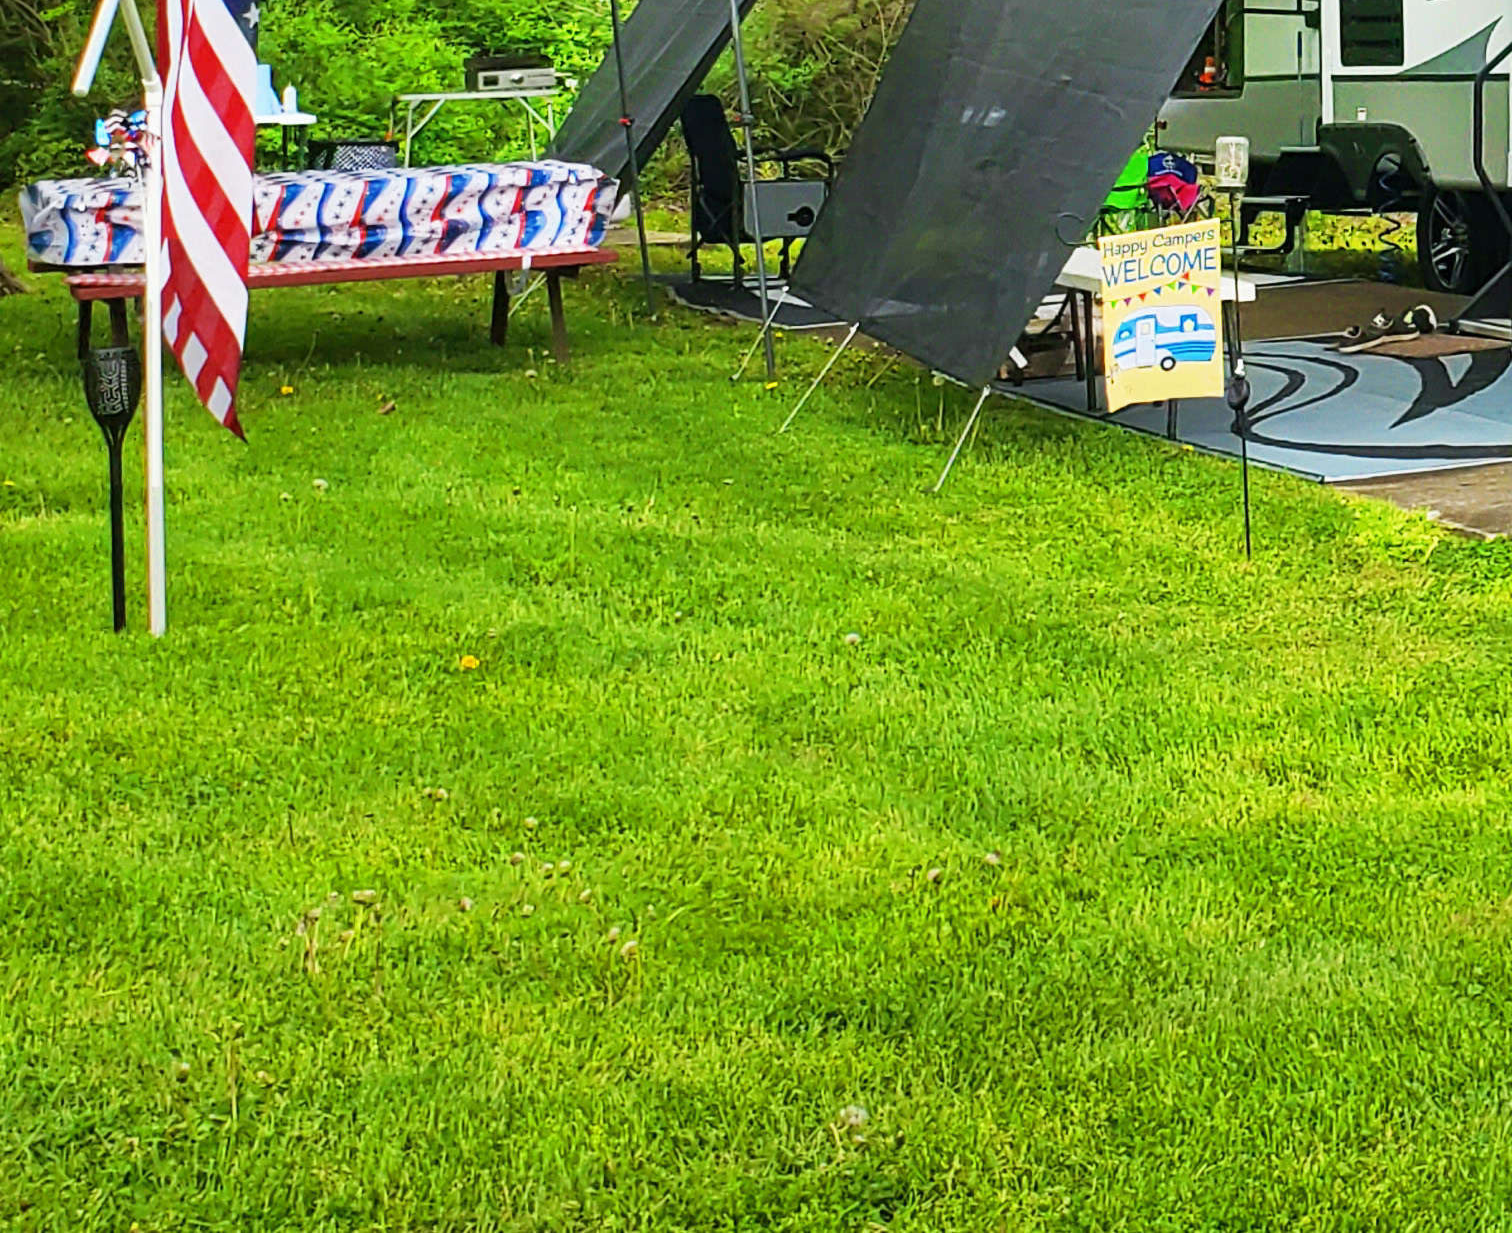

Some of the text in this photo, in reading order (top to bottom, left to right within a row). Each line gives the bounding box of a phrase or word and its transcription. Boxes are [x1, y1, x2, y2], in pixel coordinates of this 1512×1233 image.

[1103, 229, 1215, 259] Happy Campers
[1102, 247, 1217, 287] WELCOME
